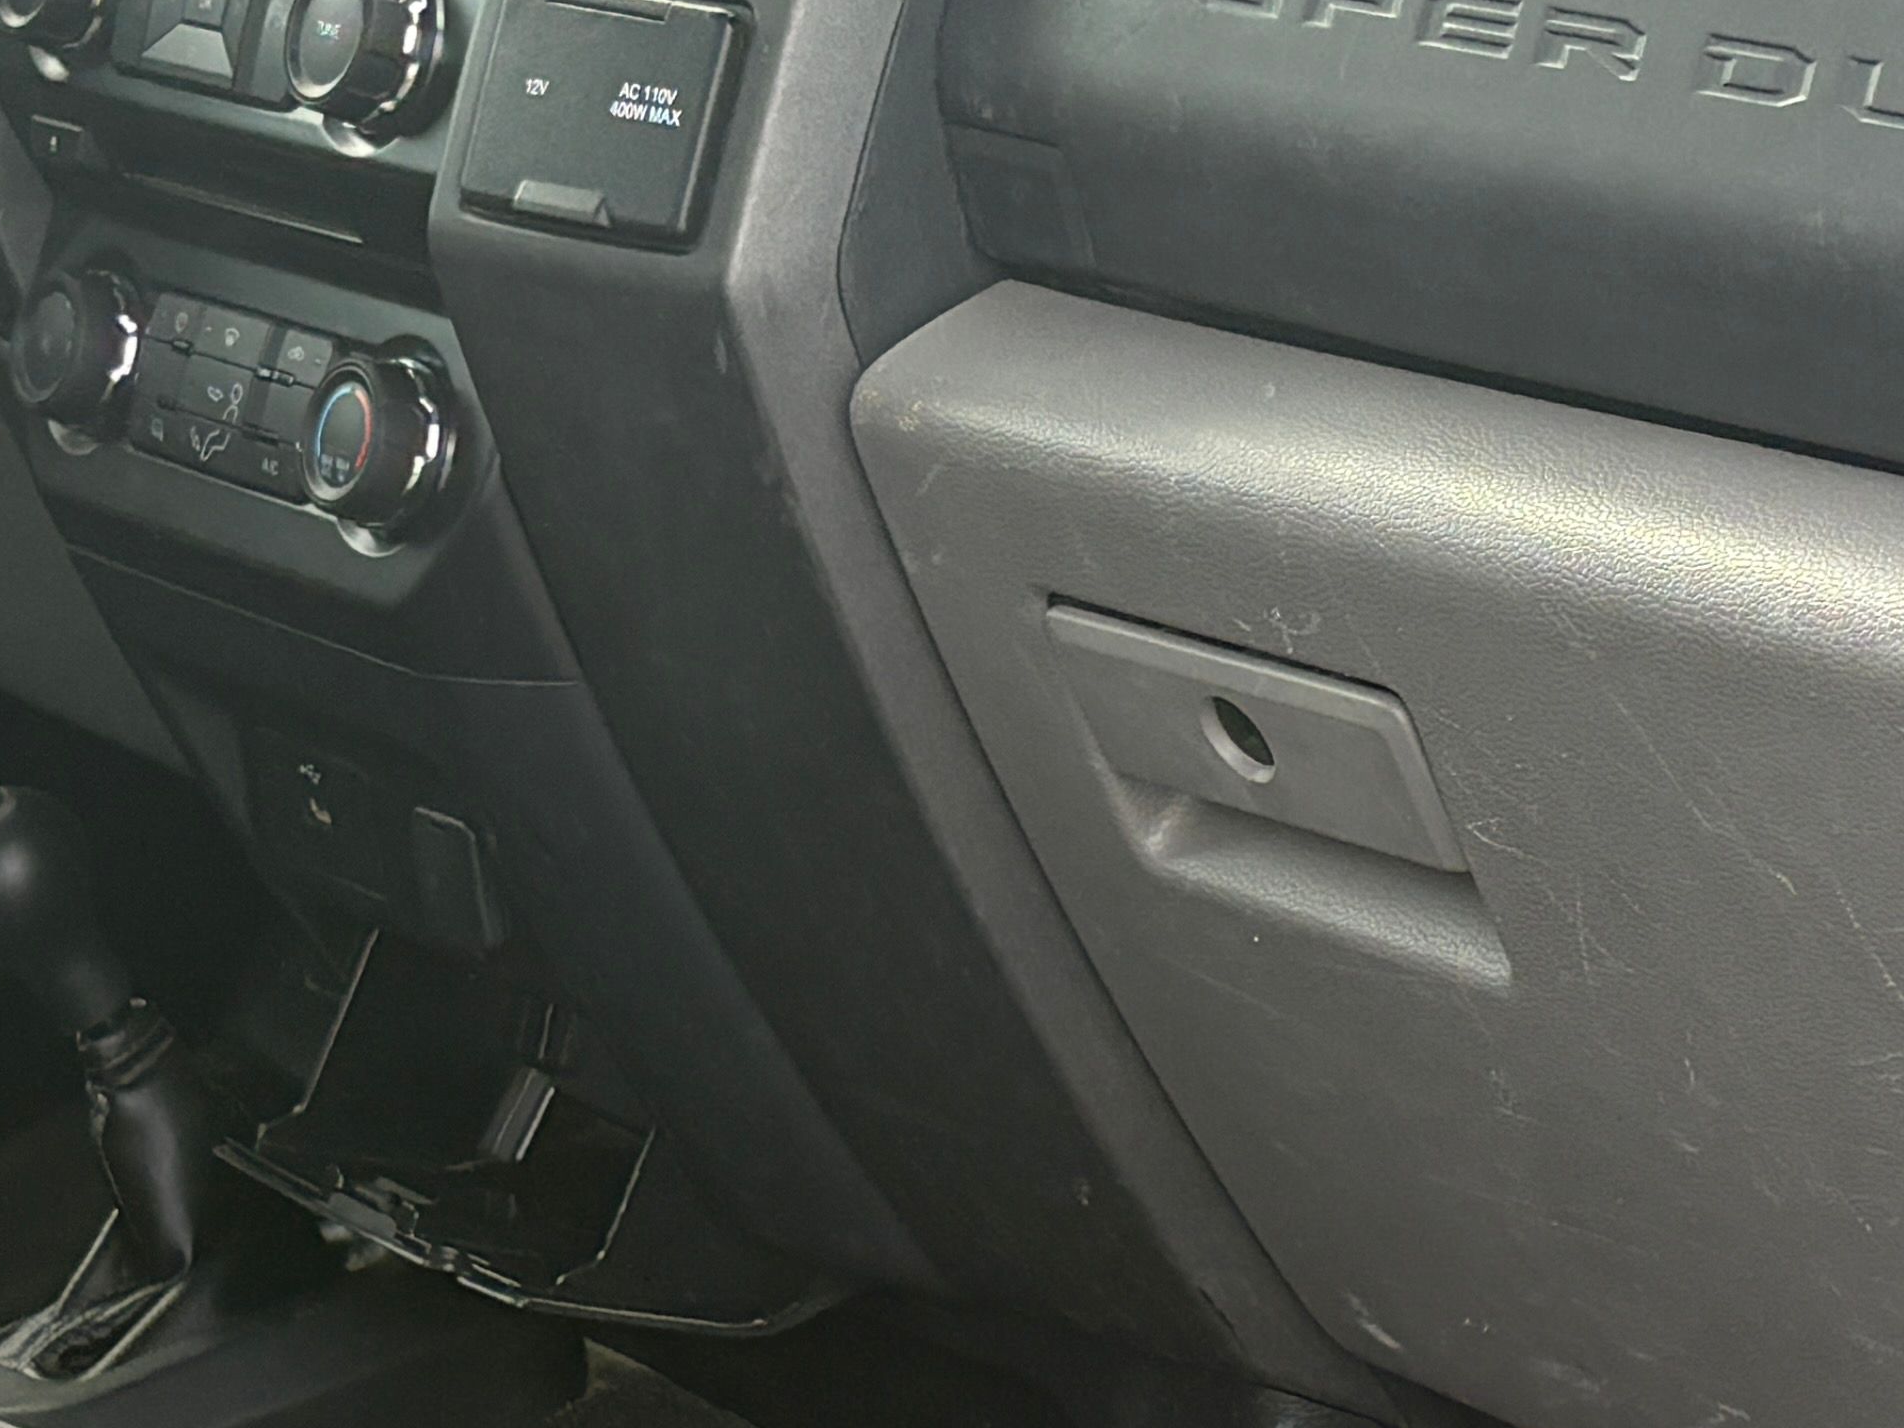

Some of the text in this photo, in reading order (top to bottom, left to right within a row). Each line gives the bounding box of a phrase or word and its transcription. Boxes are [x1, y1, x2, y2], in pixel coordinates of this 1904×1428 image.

[525, 78, 550, 96] 12V
[619, 81, 678, 106] AC 110V
[609, 101, 683, 127] 400W MAX
